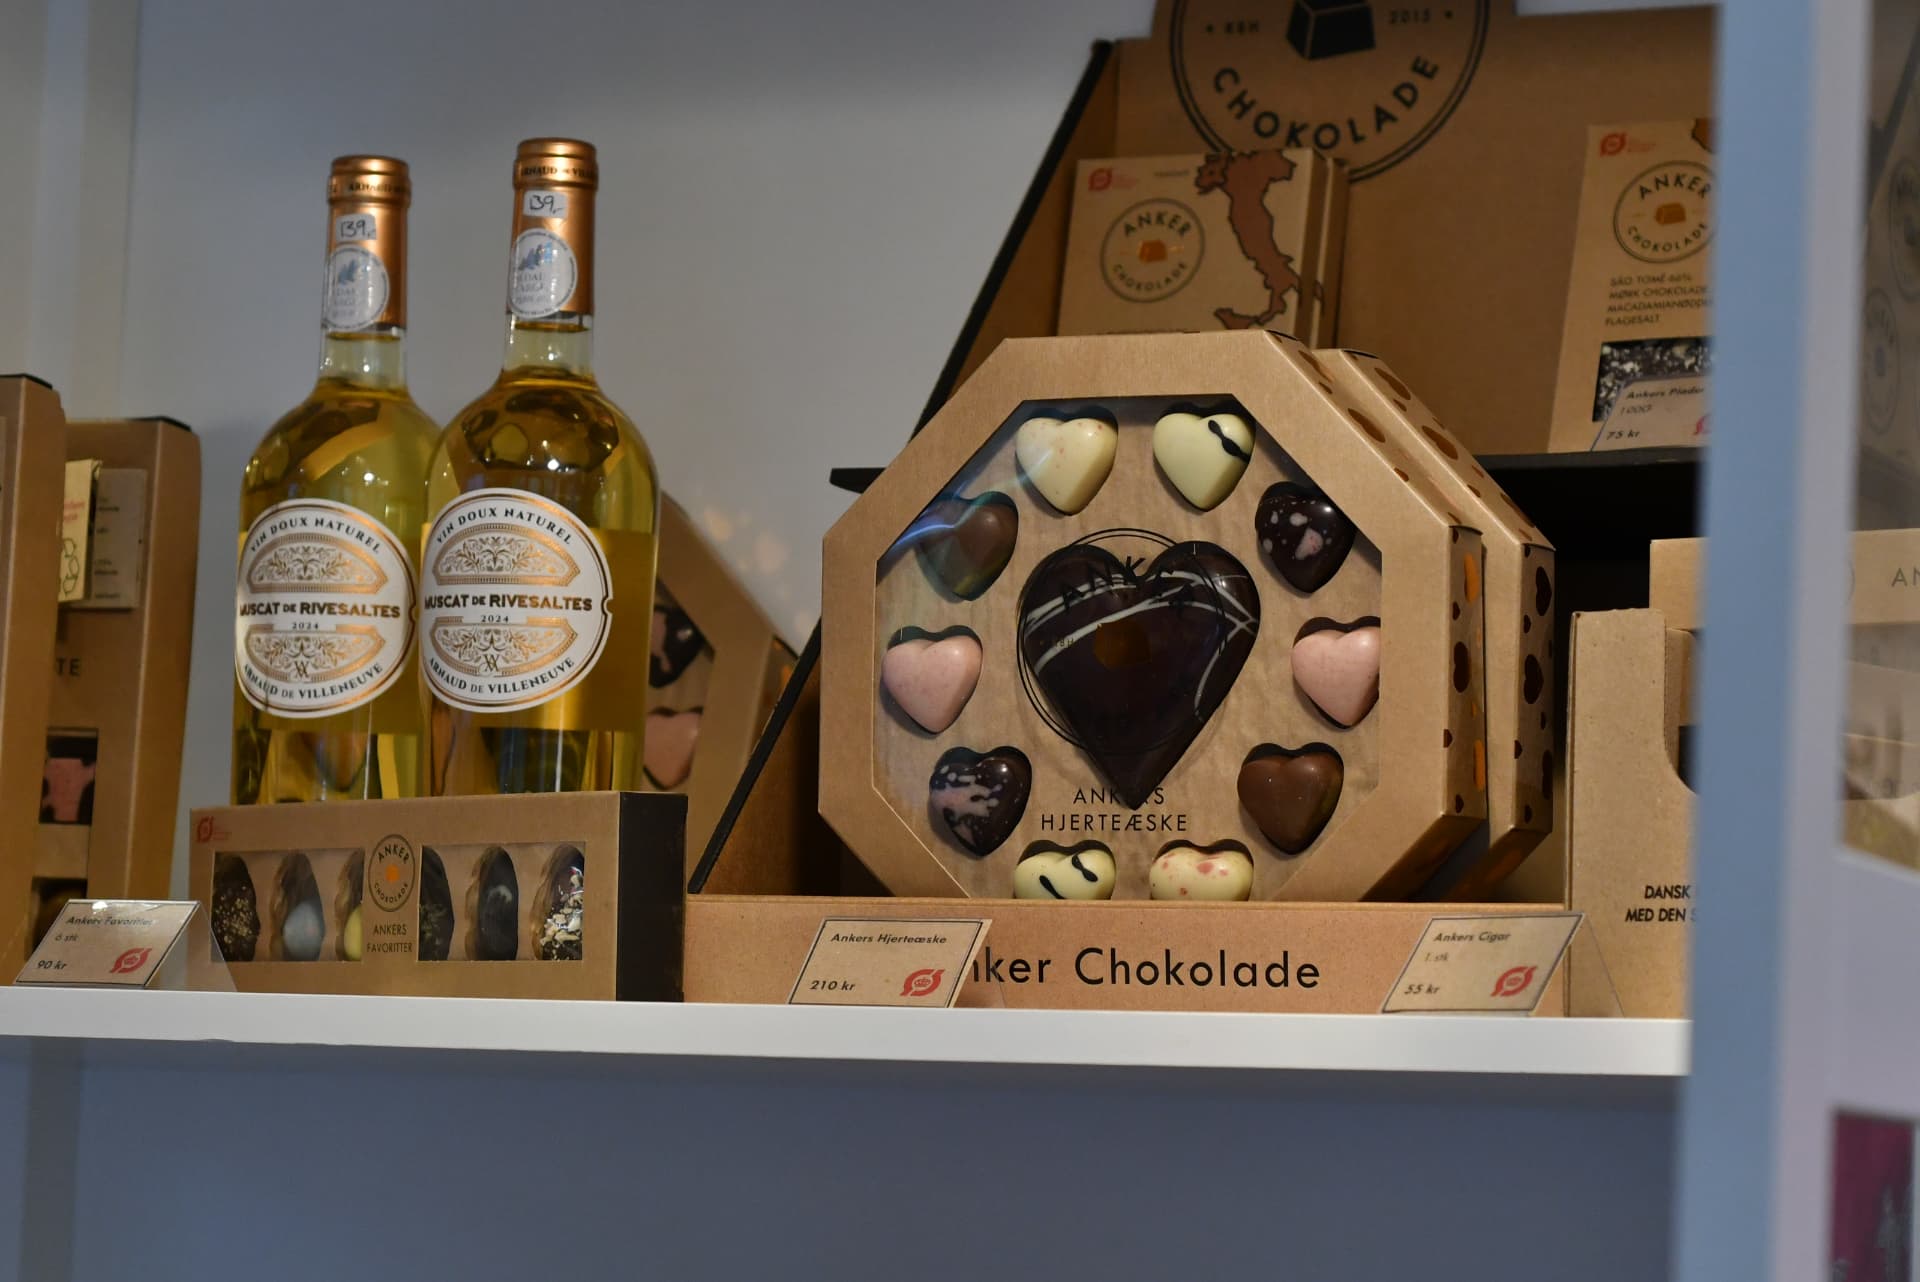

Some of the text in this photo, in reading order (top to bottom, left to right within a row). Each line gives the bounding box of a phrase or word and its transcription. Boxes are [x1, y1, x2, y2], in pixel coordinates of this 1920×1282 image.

[1213, 55, 1439, 150] CHOKOLADE
[1123, 209, 1191, 238] ANKER
[1628, 429, 1640, 438] kr
[437, 507, 572, 545] VIN DOUX NATUREL
[251, 517, 382, 554] VIN DOUX NATUREL
[283, 603, 297, 613] DE
[300, 602, 400, 618] RIVESALTES
[472, 595, 486, 606] DE
[489, 594, 592, 611] RIVESALTES
[292, 622, 319, 630] 2024
[481, 615, 510, 623] 2024
[281, 690, 294, 698] DE
[299, 663, 383, 699] VILLENEUVE
[429, 657, 575, 693] ARNAUD DE VILLENEUVE
[1073, 787, 1165, 805] ANKS
[1041, 814, 1187, 832] HJERTEÆSKE
[377, 844, 410, 864] ANKER
[1625, 908, 1654, 922] MED
[1658, 908, 1686, 922] DEN
[372, 922, 408, 936] ANKERS
[831, 933, 947, 945] Ankers Hjerteæske
[1433, 931, 1511, 944] Ankers Cigar
[366, 942, 414, 954] FAVORITTER
[37, 960, 67, 971] 90 kr
[972, 946, 1321, 988] nker Chokolade
[809, 979, 855, 992] 210 kr
[1404, 983, 1440, 994] 55 kr
